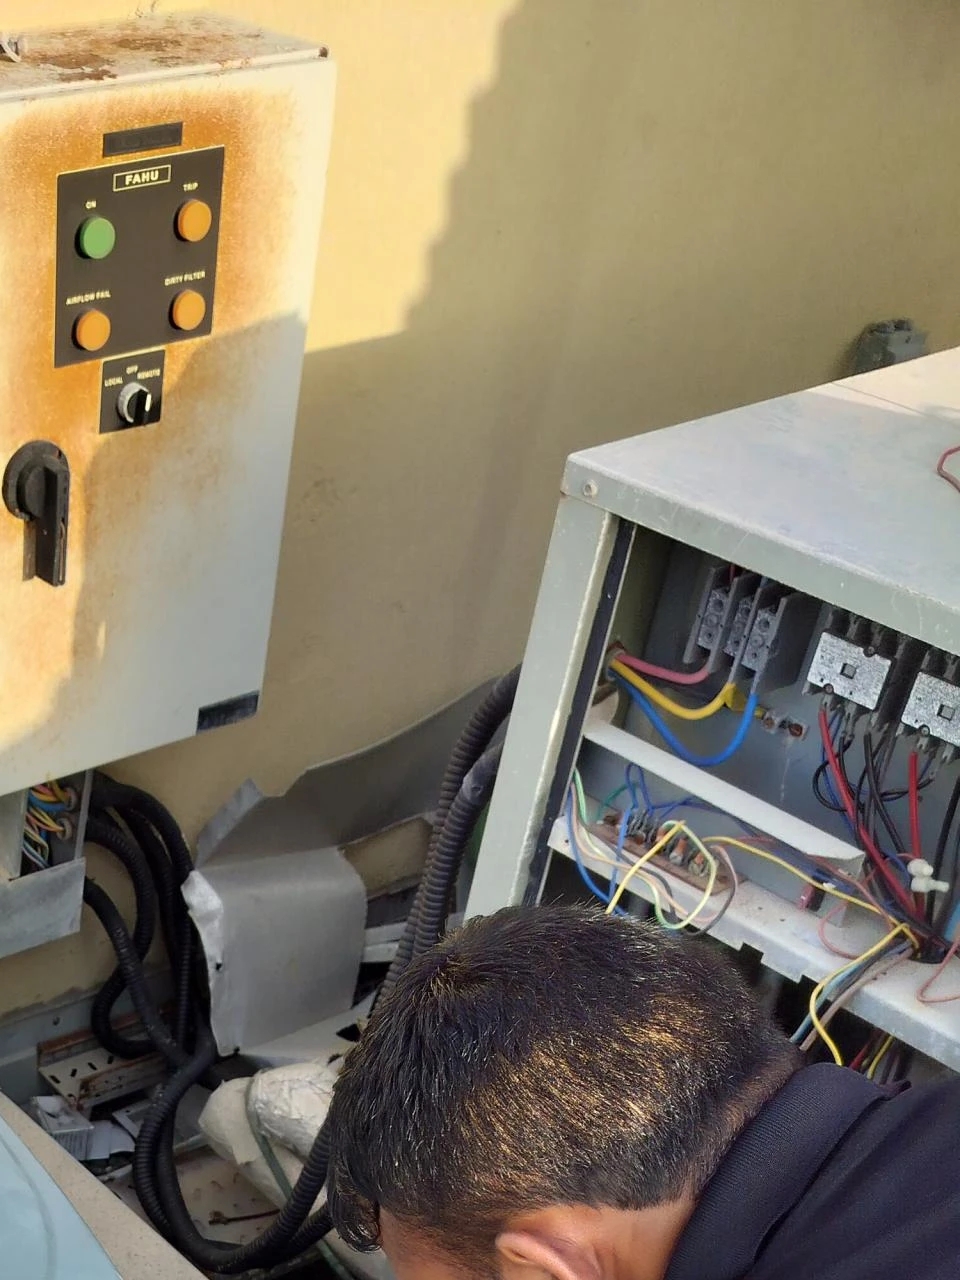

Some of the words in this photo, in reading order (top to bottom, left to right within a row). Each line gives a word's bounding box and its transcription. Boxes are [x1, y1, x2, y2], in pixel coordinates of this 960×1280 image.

[125, 170, 159, 186] FAHU
[183, 182, 199, 192] TRIP
[85, 200, 97, 209] ON
